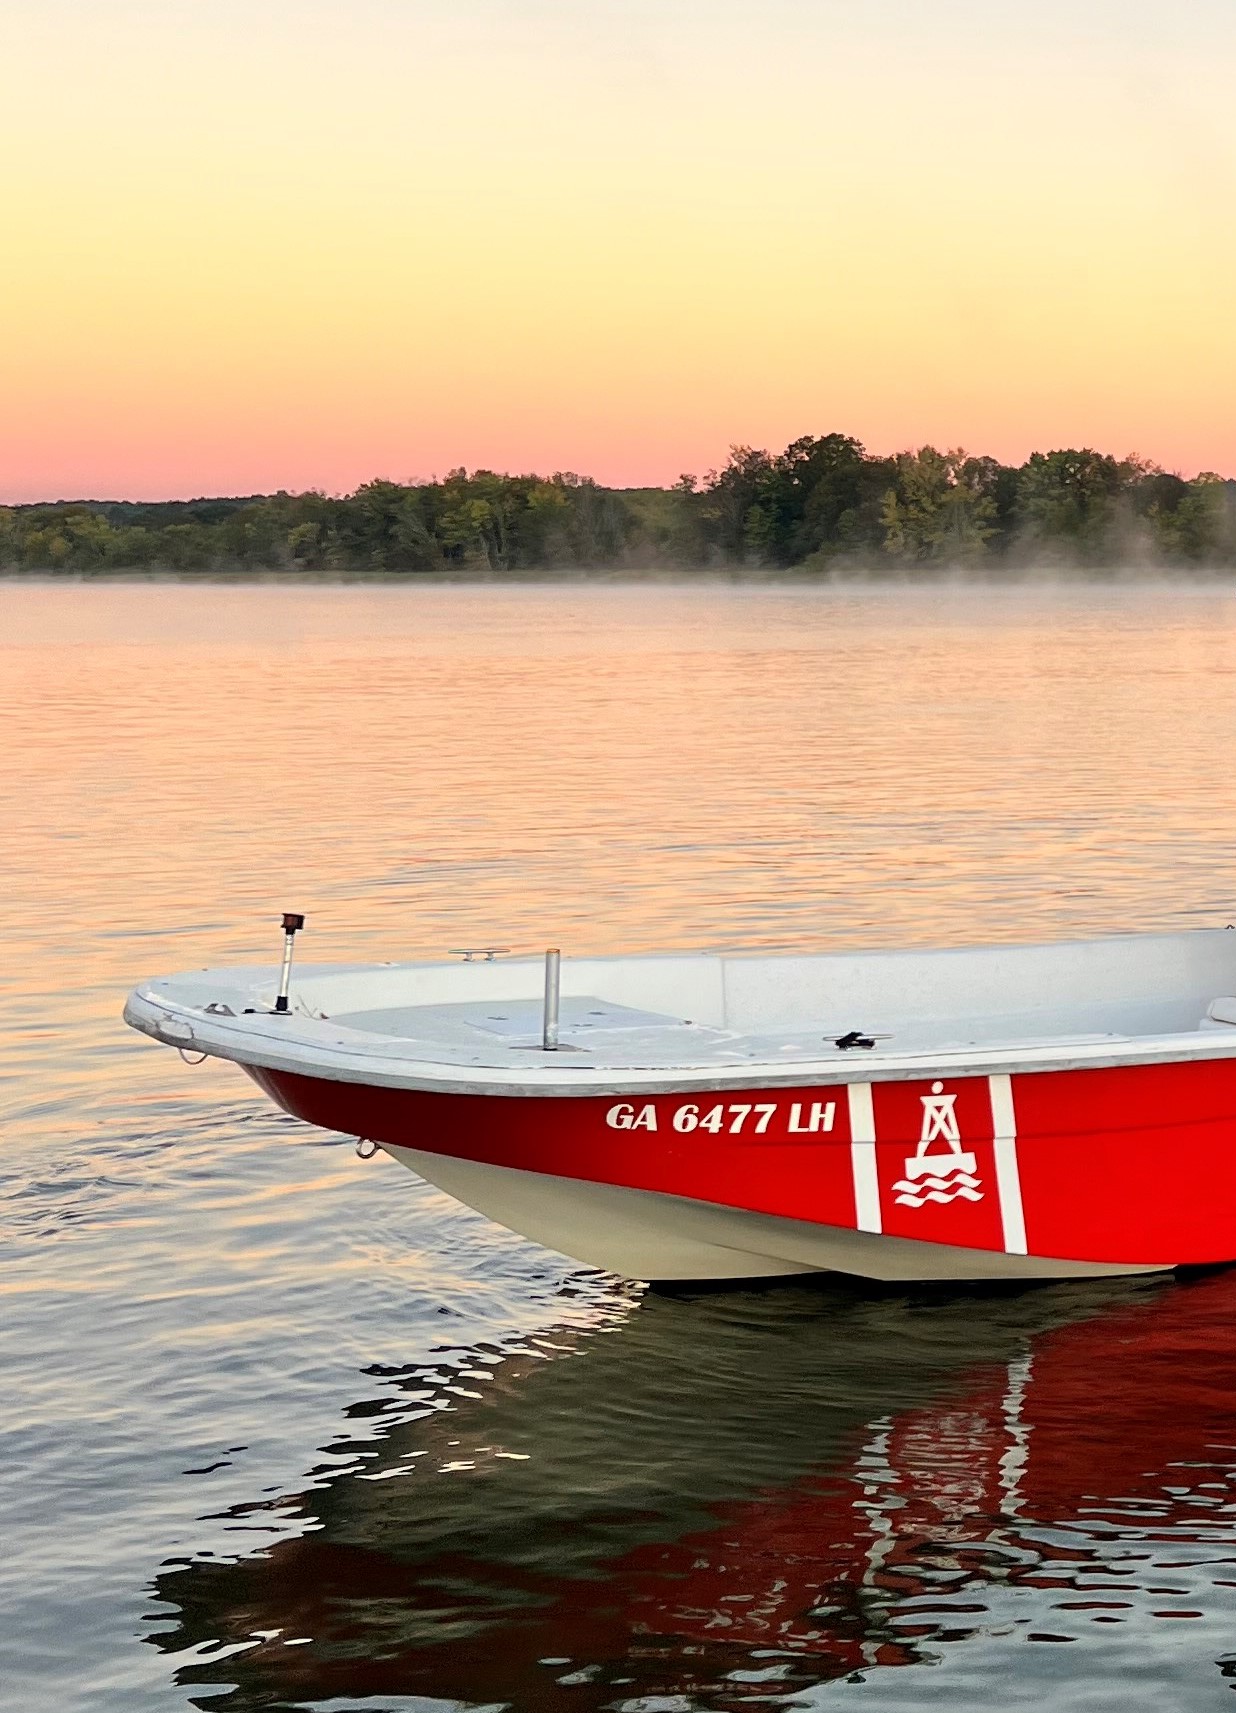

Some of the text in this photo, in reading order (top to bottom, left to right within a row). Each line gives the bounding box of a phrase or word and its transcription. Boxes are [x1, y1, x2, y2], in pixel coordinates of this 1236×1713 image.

[605, 1102, 836, 1134] GA 6477 LH
